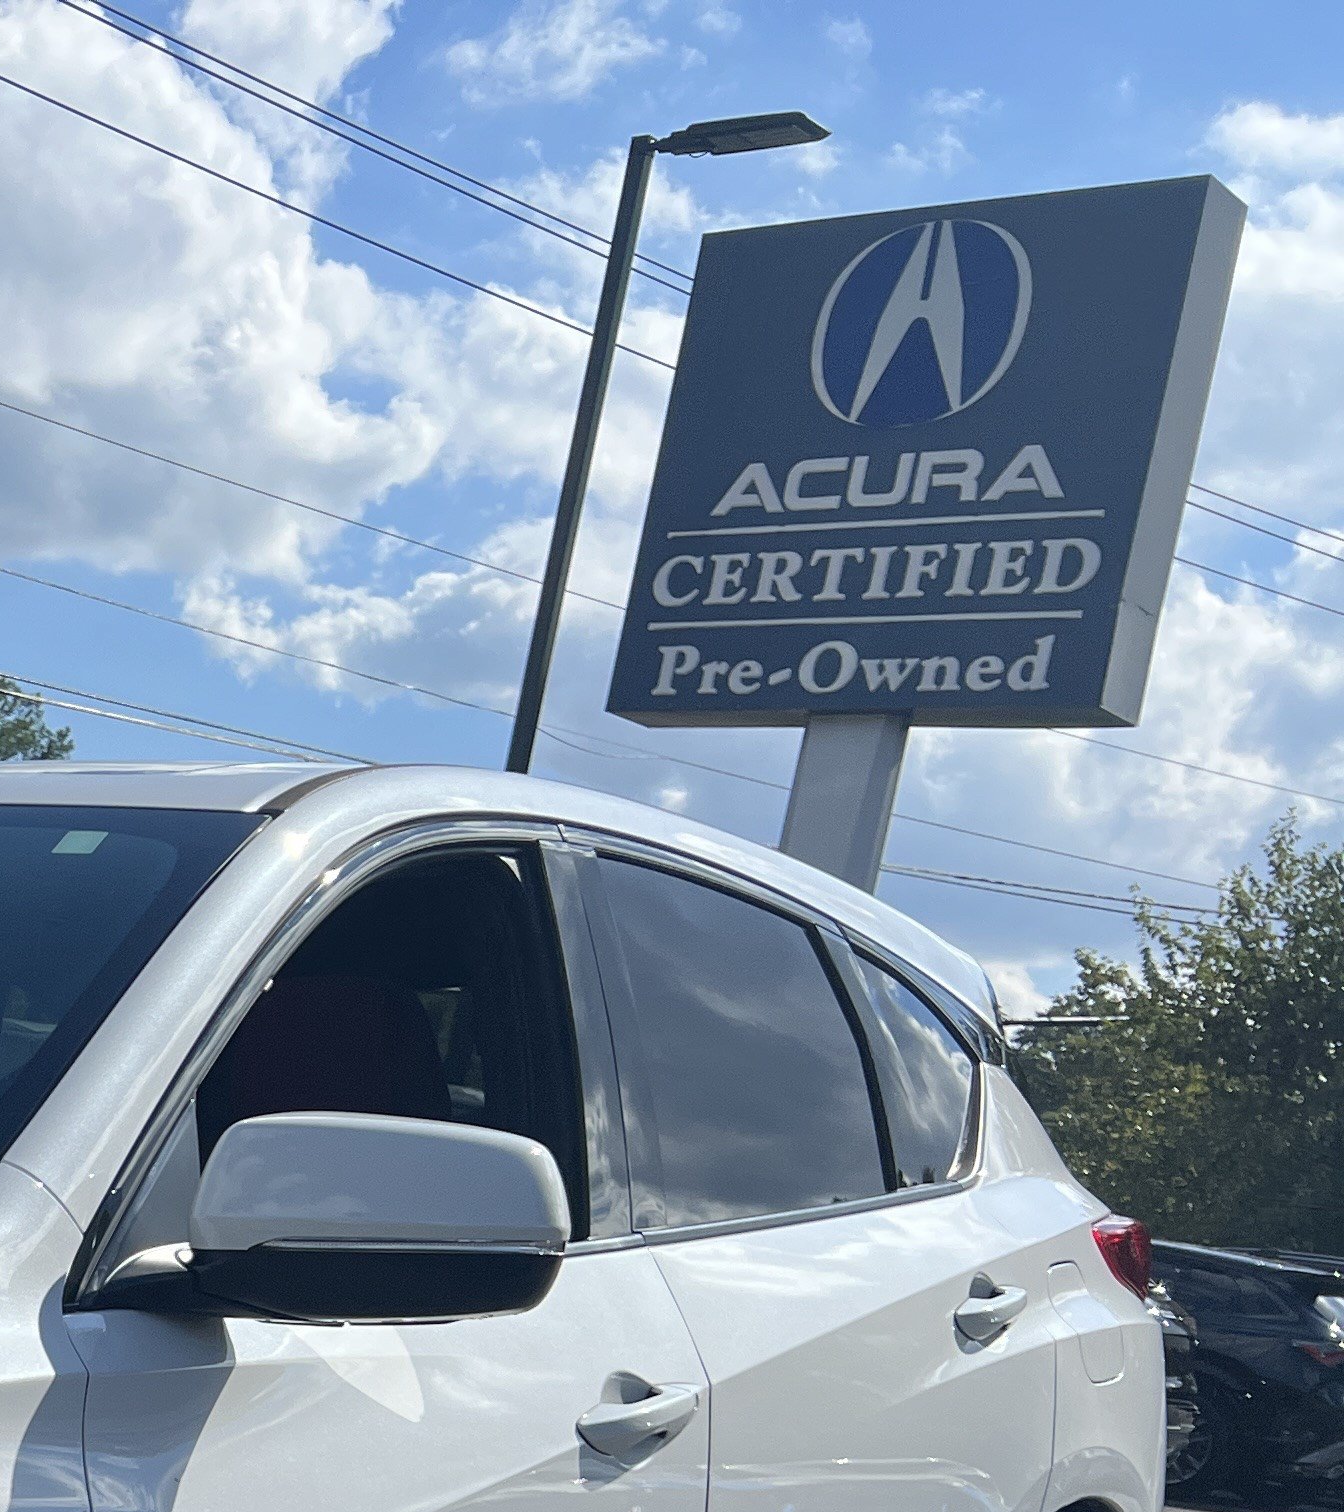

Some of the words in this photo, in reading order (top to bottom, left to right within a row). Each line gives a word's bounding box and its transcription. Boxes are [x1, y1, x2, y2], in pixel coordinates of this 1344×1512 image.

[710, 444, 1066, 517] ACURA
[651, 537, 1103, 607] CERTIFIED
[650, 634, 1057, 697] Pre-Owned
